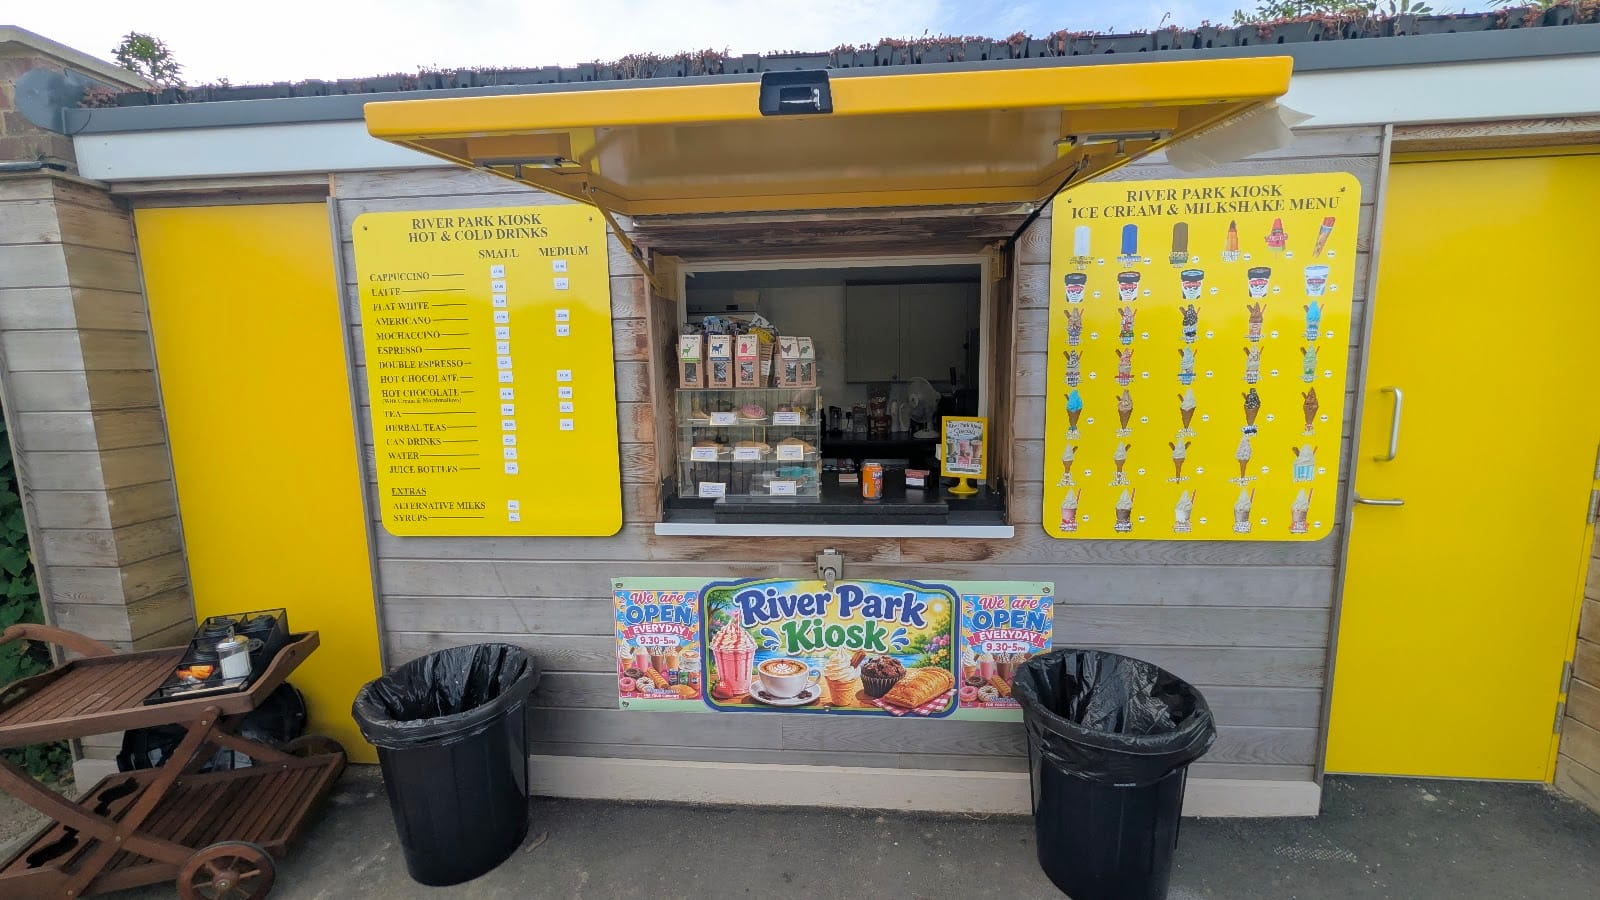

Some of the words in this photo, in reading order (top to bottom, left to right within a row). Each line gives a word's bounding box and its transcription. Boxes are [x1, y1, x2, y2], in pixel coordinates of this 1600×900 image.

[1126, 189, 1177, 202] RIVER
[1182, 187, 1225, 201] PARK
[1230, 184, 1283, 199] KIOSK
[1072, 206, 1099, 219] ICE
[1103, 203, 1162, 217] CREAM
[1166, 203, 1179, 216] &
[1184, 199, 1285, 215] MILKSHAKE
[1289, 196, 1340, 210] MENU
[412, 217, 454, 229] RIVER
[458, 215, 494, 228] PARK
[498, 213, 542, 226] KIOSK
[409, 231, 437, 243] HOT
[441, 230, 452, 242] &
[454, 228, 492, 241] COLD
[496, 226, 548, 239] DRINKS
[479, 248, 519, 259] SMALL
[539, 245, 589, 257] MEDIUM
[369, 271, 430, 282] CAPPUCCINO
[371, 287, 401, 297] LATTE
[373, 303, 395, 312] FLAT
[398, 301, 429, 311] WHITE
[375, 316, 431, 326] AMERICANO
[376, 330, 440, 341] MOCHACCINO
[377, 345, 423, 355] ESPRESSO
[379, 360, 416, 369] DOUBLE
[418, 359, 464, 368] ESPRESSO
[380, 375, 400, 384] HOT
[401, 373, 459, 383] CHOCOLATE
[381, 389, 401, 398] HOT
[402, 388, 459, 397] CHOCOLATE
[384, 410, 402, 418] TEA
[385, 424, 422, 432] HERBAL
[424, 423, 447, 432] TEAS
[386, 438, 404, 446] CAN
[407, 437, 442, 446] DRINKS
[388, 451, 420, 460] WATER
[389, 465, 416, 474] JUICE
[417, 465, 458, 473] BOTTLES
[391, 487, 427, 496] EXTRAS
[393, 501, 454, 510] ALTERNATIVE
[458, 501, 486, 510] MILKS
[393, 513, 428, 522] SYRUPS
[630, 591, 654, 605] We
[659, 593, 684, 603] are
[979, 597, 1005, 609] We
[1012, 599, 1038, 609] are
[736, 587, 831, 625] River
[836, 585, 927, 627] Park
[626, 604, 693, 625] OPEN
[972, 609, 1046, 631] OPEN
[633, 624, 686, 635] EVERYDAY
[783, 619, 888, 653] Kiosk
[980, 630, 1037, 641] EVERYDAY
